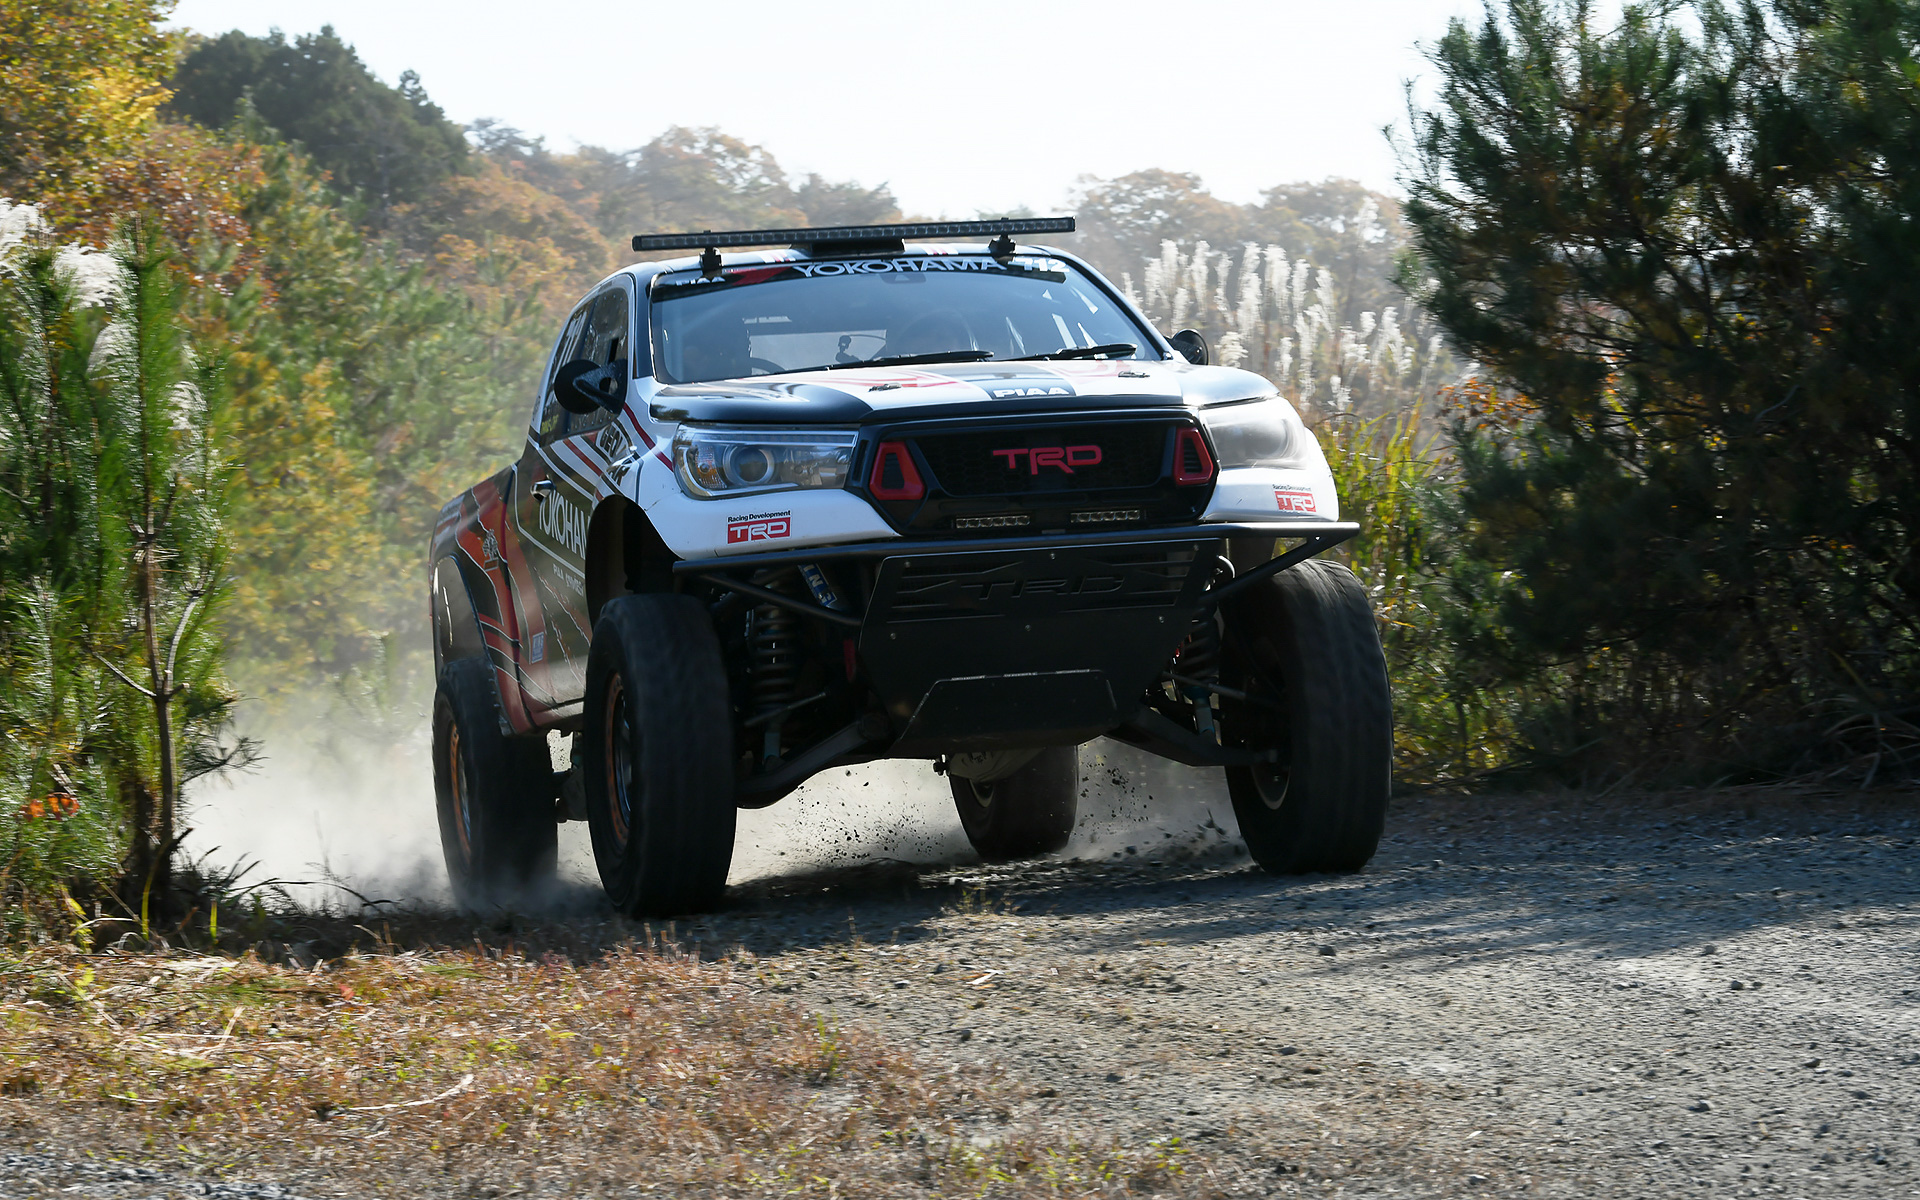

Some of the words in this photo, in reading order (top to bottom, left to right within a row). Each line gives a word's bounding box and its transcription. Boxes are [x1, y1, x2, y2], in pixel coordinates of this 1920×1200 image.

[793, 258, 1007, 278] YOKOHAMA
[992, 387, 1070, 398] PIAA
[993, 445, 1103, 475] TRD
[1277, 494, 1315, 512] TRD
[728, 514, 749, 523] Racing
[749, 510, 791, 520] Development
[730, 521, 787, 541] TRD
[960, 575, 1126, 601] TRD
